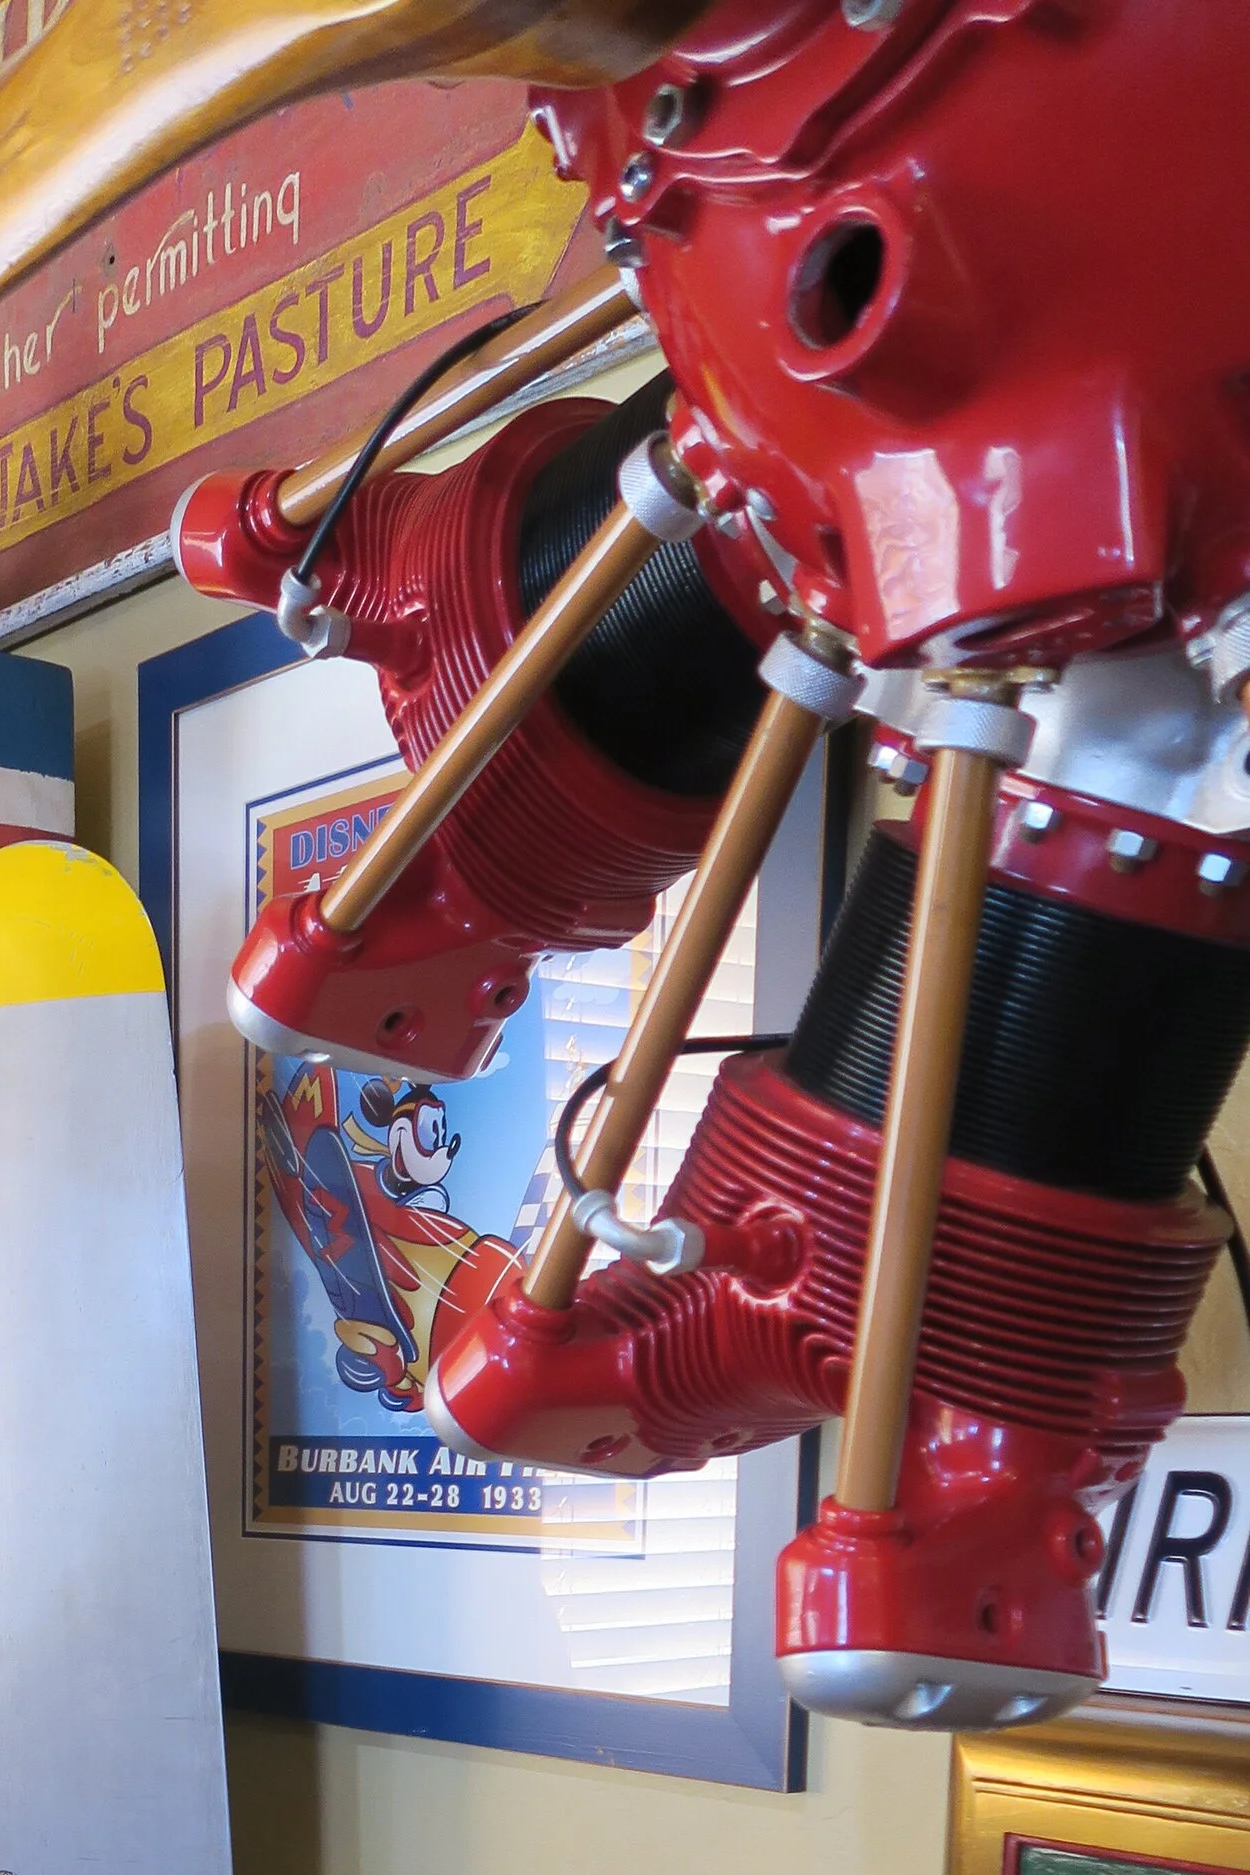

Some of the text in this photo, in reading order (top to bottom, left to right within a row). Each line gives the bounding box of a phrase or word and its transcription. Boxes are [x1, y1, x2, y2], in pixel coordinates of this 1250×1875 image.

[97, 171, 302, 354] permitting
[193, 174, 493, 430] PASTURE
[277, 1444, 419, 1475] BURBANK
[330, 1482, 542, 1511] AUG 22-28 1933
